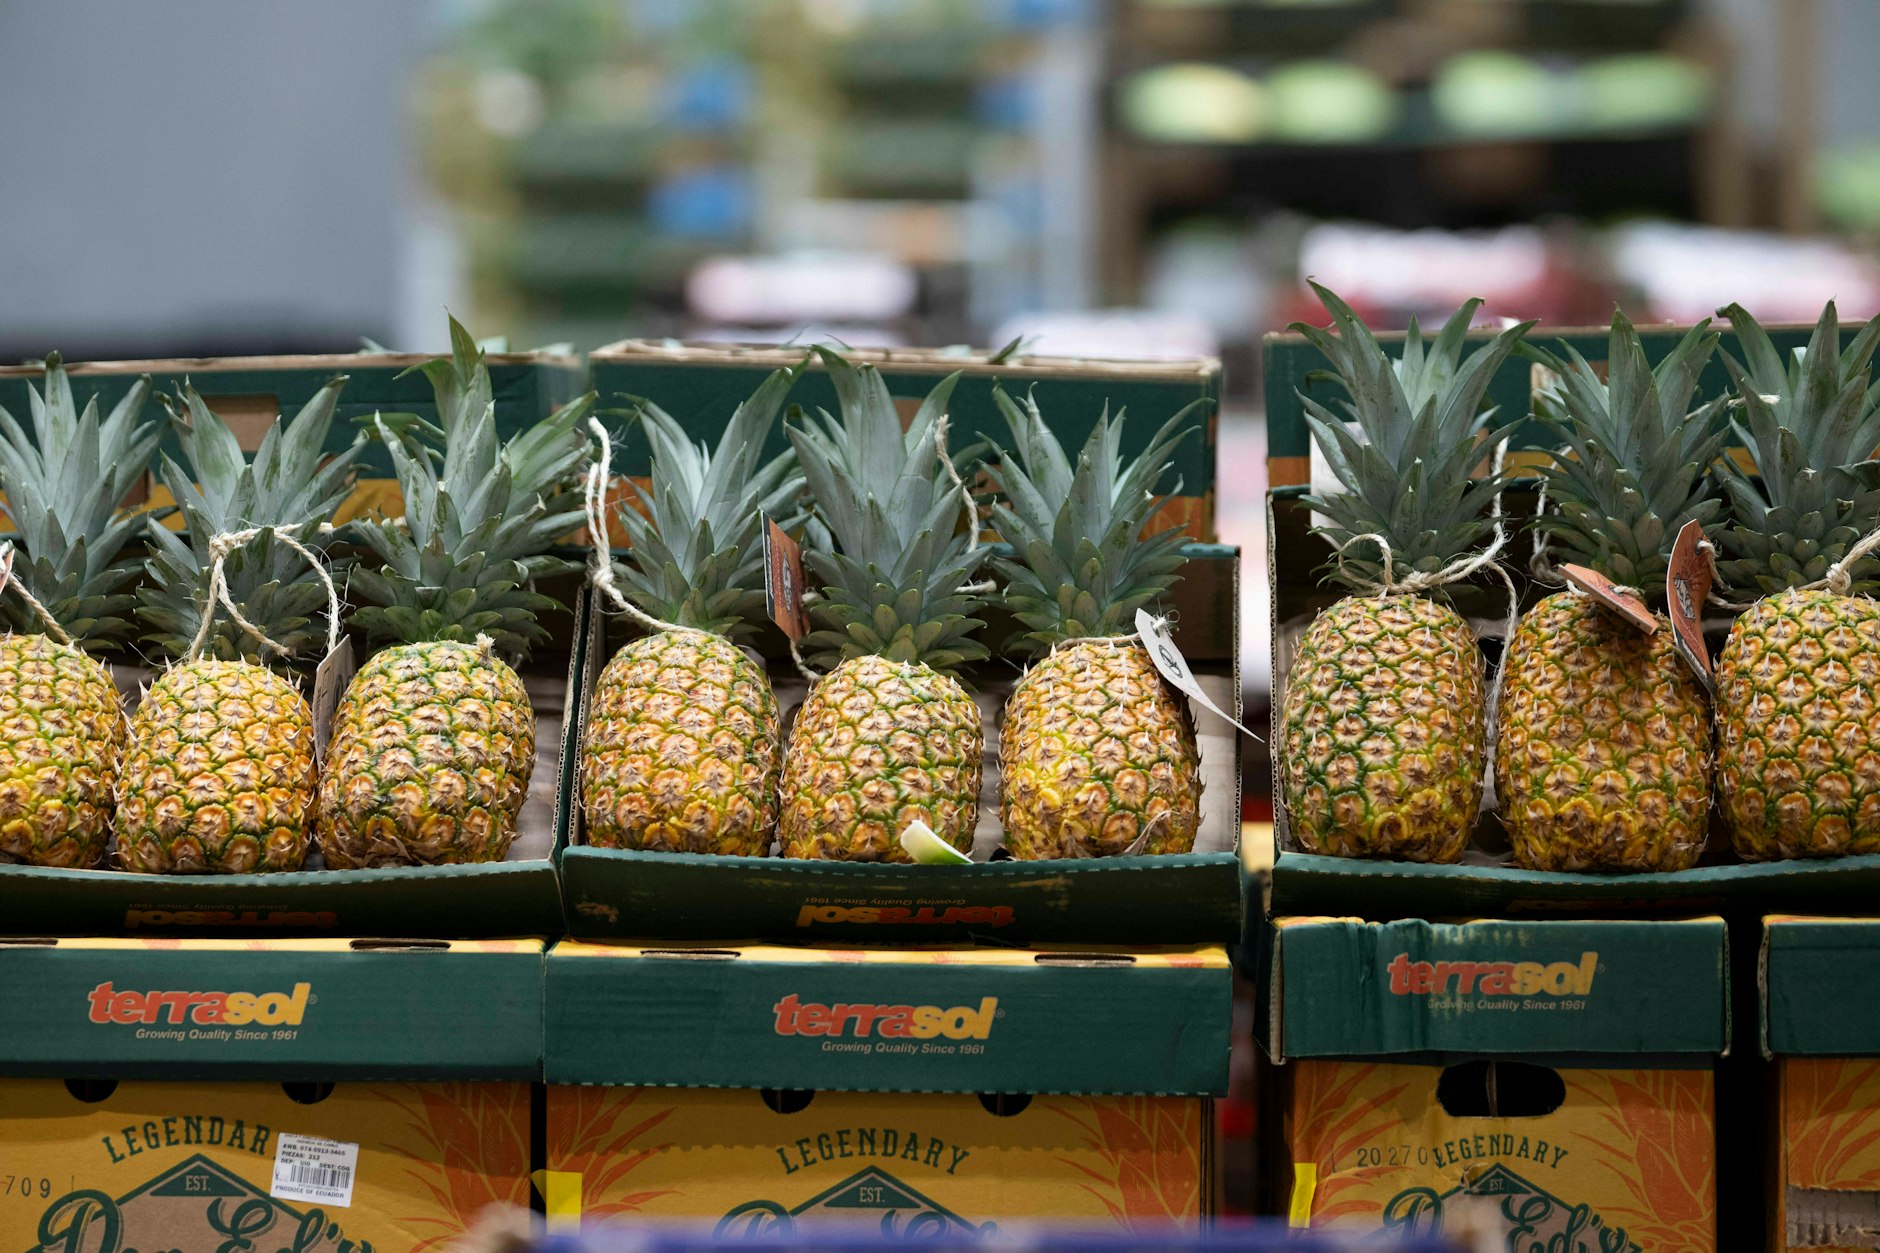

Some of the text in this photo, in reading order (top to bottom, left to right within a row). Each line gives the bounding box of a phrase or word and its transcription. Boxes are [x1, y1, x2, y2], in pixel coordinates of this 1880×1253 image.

[1387, 951, 1599, 996] terrasol
[88, 981, 312, 1026] terrasol
[773, 993, 999, 1040] terrasol
[1477, 999, 1520, 1012] Quality
[1522, 999, 1556, 1010] Since
[1559, 1001, 1586, 1010] 1961
[135, 1028, 298, 1041] Growing Quality Since 1961
[821, 1041, 985, 1055] Growing Quality Since 1961
[102, 1115, 277, 1164] LEGENDAR
[777, 1127, 970, 1175] LEGENDARY
[1432, 1133, 1569, 1168] LEGENDARY
[185, 1175, 212, 1192] EST.
[275, 1184, 304, 1194] PRODUCE
[315, 1188, 345, 1199] ECUADOR
[859, 1186, 885, 1203] EST.
